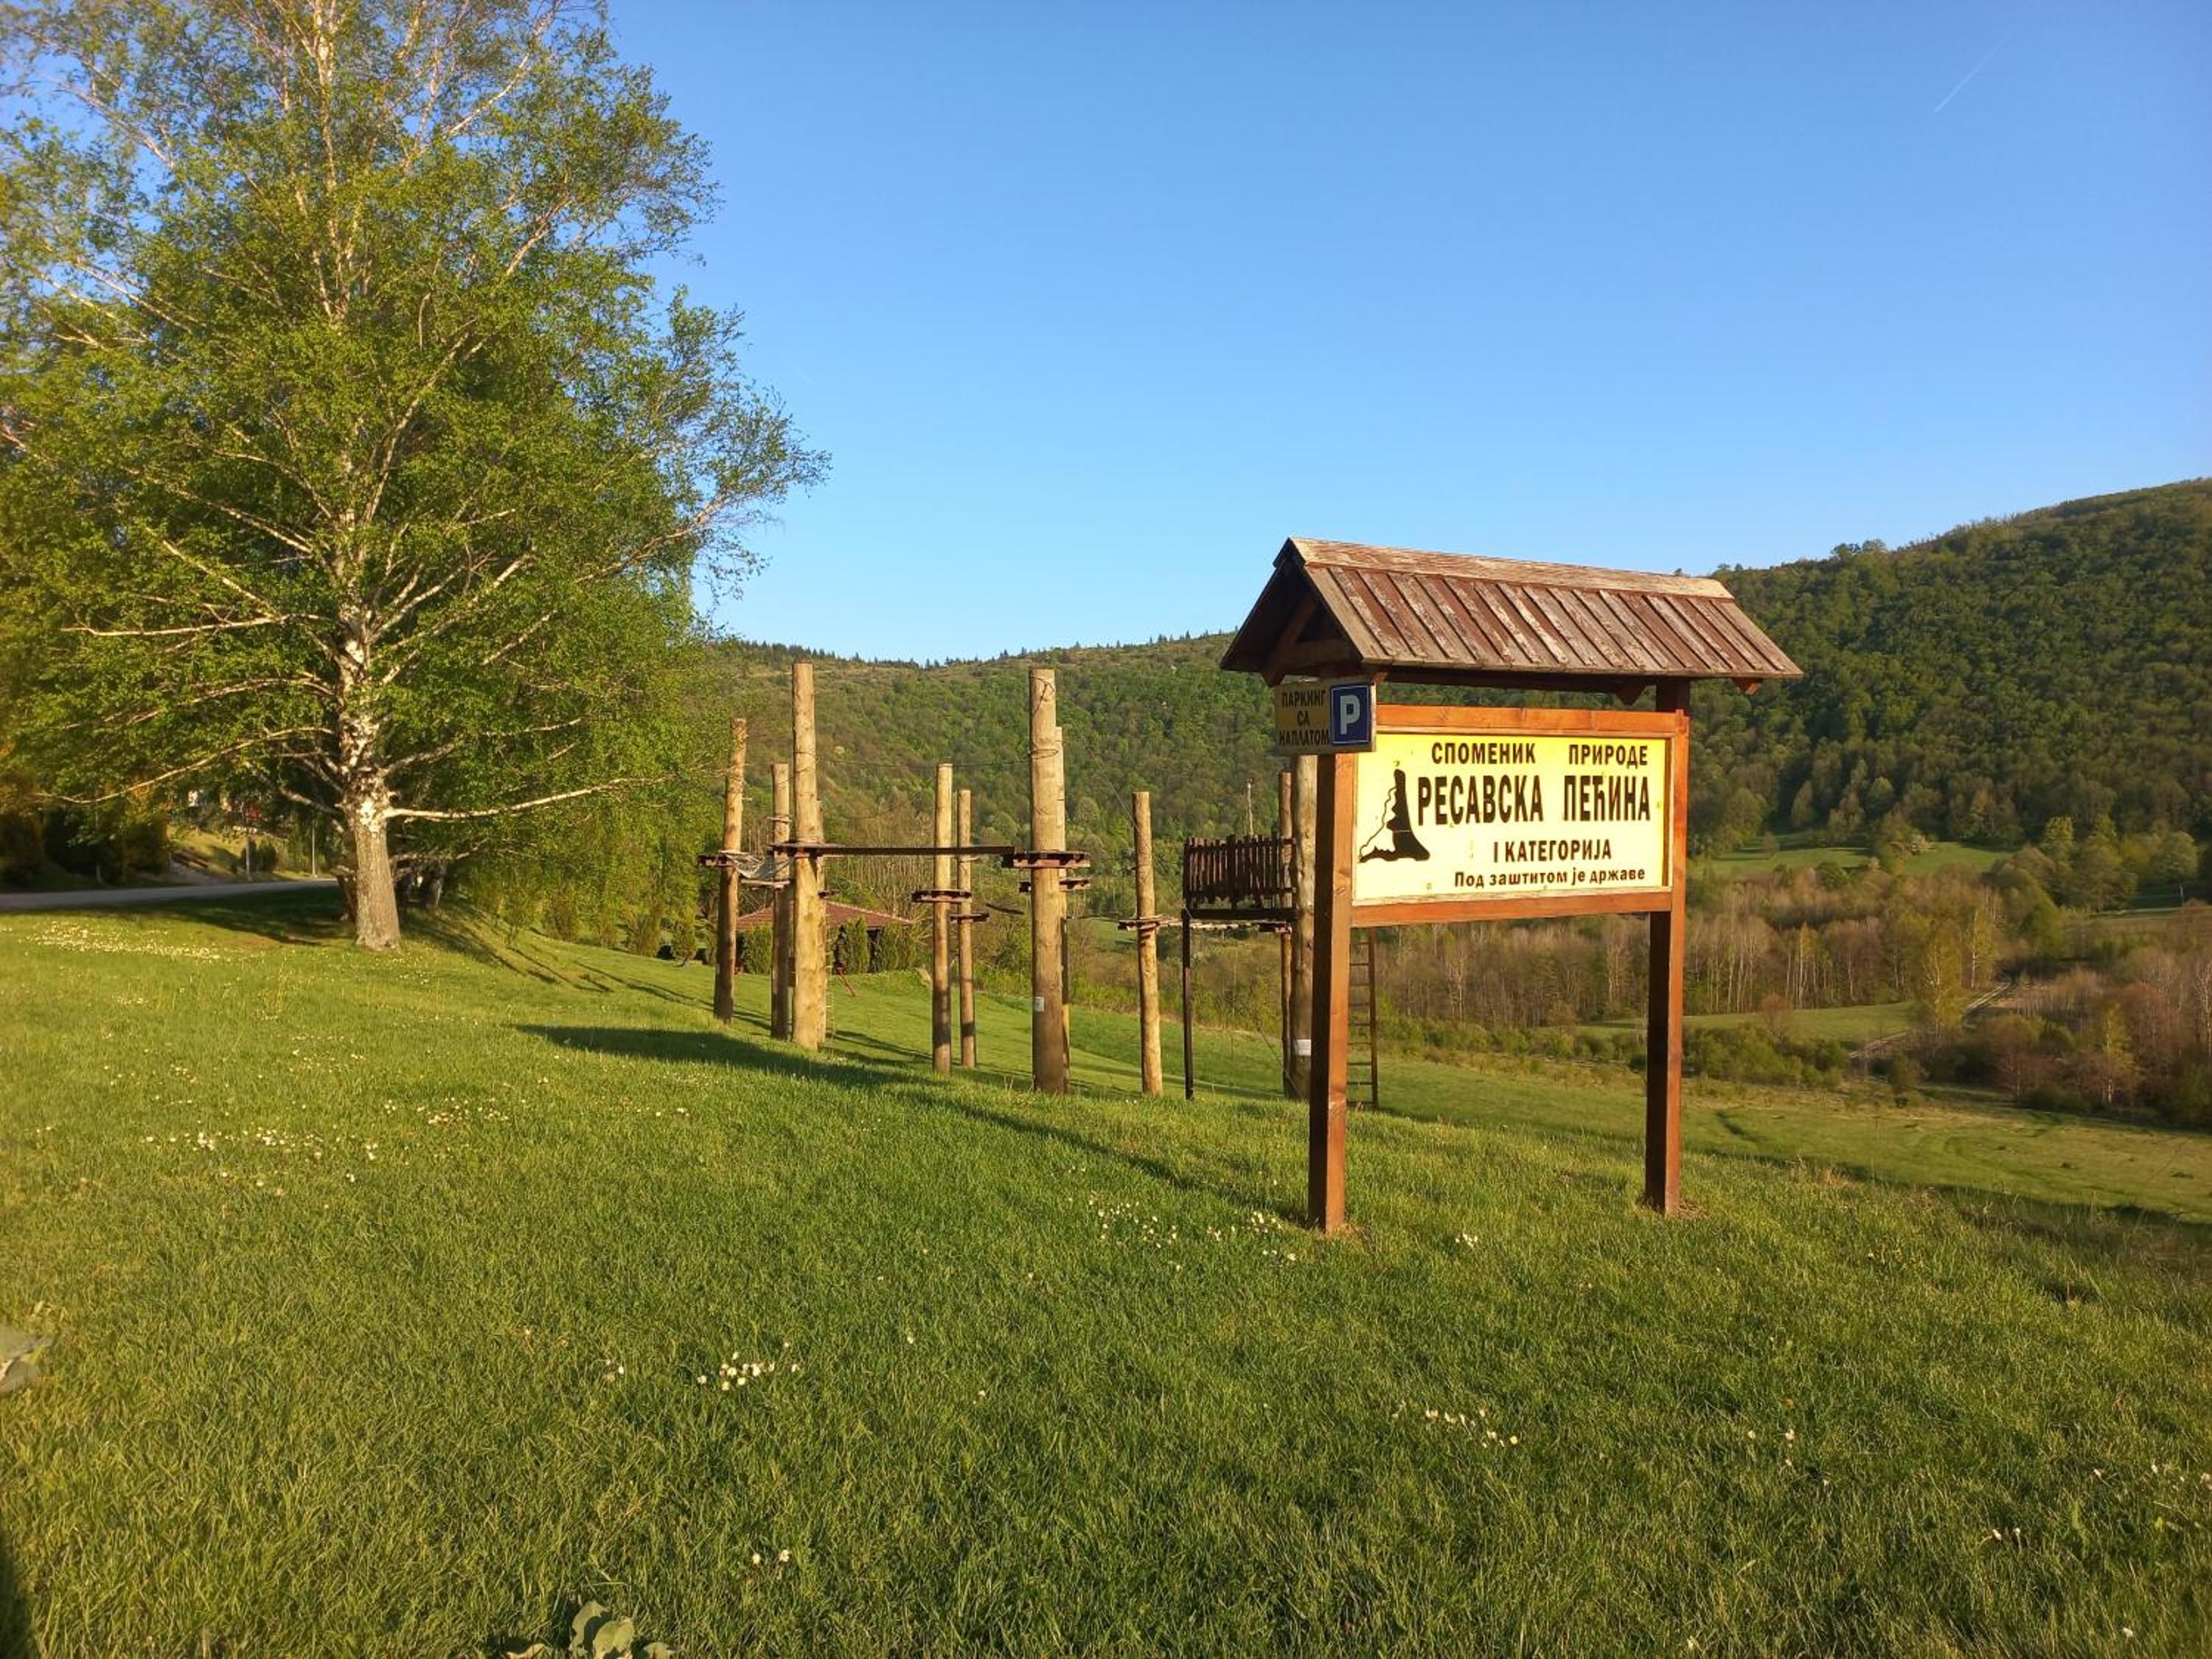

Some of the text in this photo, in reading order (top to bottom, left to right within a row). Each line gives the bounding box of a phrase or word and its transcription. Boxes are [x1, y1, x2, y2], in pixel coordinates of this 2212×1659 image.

[1281, 689, 1326, 708] ПАРКИНГ
[1297, 710, 1310, 727] СА
[1340, 695, 1360, 735] P
[1431, 742, 1649, 769] СПОМЕНИК ПРИРОДЕ
[1418, 774, 1651, 827] РЕСАВСКА ПЕЋИНА
[1505, 839, 1612, 862] КАТЕГОРИЈА
[1455, 866, 1645, 888] Под заштитом је државе
